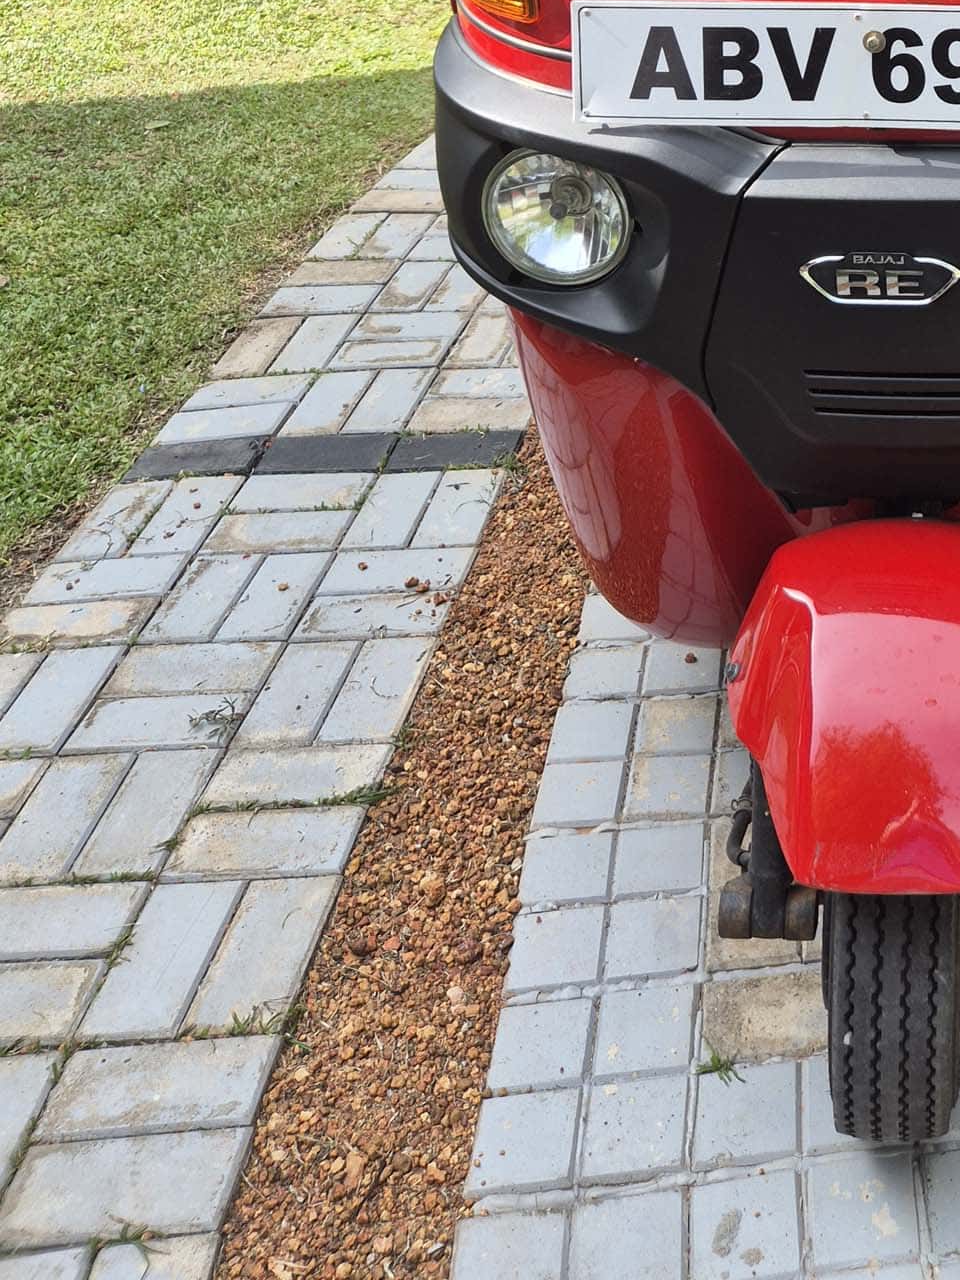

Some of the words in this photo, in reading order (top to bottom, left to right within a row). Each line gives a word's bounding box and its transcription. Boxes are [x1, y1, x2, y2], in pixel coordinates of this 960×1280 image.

[629, 26, 837, 102] ABV
[852, 254, 905, 265] BAJAJ
[836, 269, 925, 297] RE
